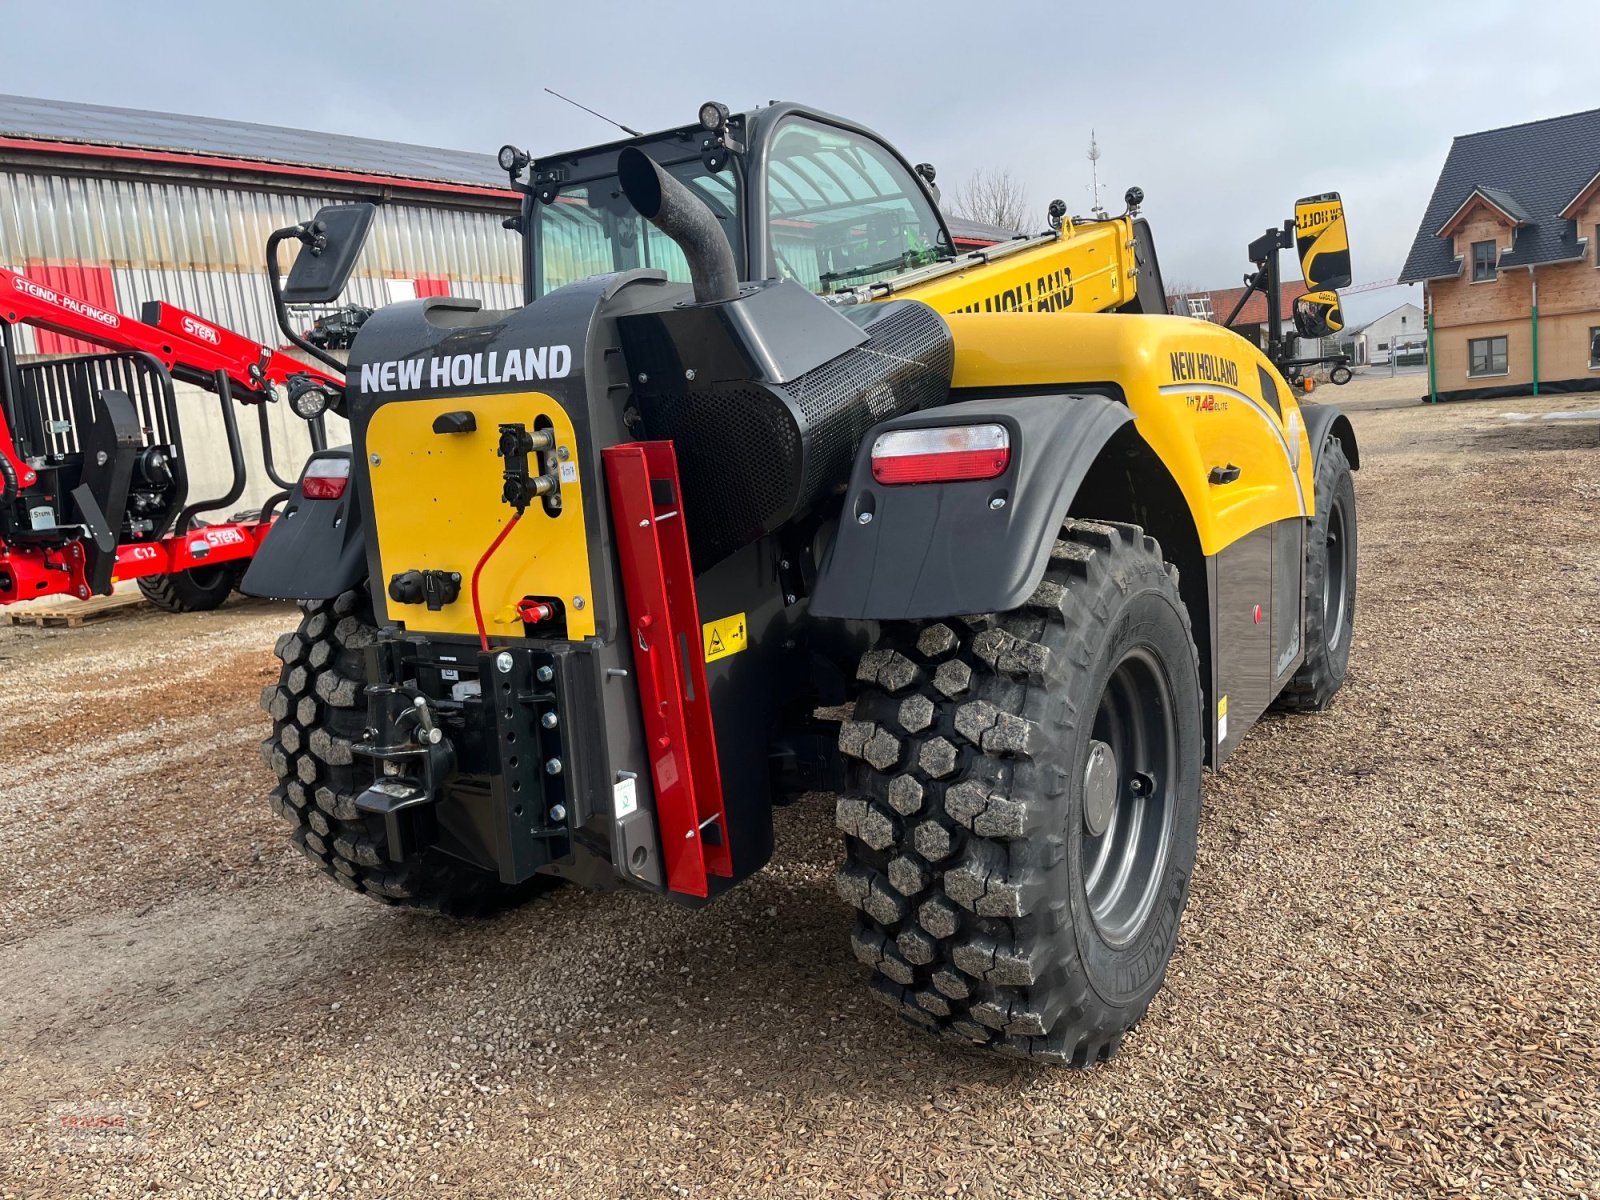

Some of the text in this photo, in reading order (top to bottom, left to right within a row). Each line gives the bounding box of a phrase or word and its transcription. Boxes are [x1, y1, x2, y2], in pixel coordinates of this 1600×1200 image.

[16, 279, 117, 327] STEINDL-PALFINGER
[184, 318, 218, 344] STEPA
[361, 344, 572, 393] NEW HOLLAND
[1170, 352, 1238, 386] NEW HOLLAND
[1214, 402, 1228, 411] ELITE
[207, 528, 243, 546] STEPA
[134, 547, 157, 559] C12
